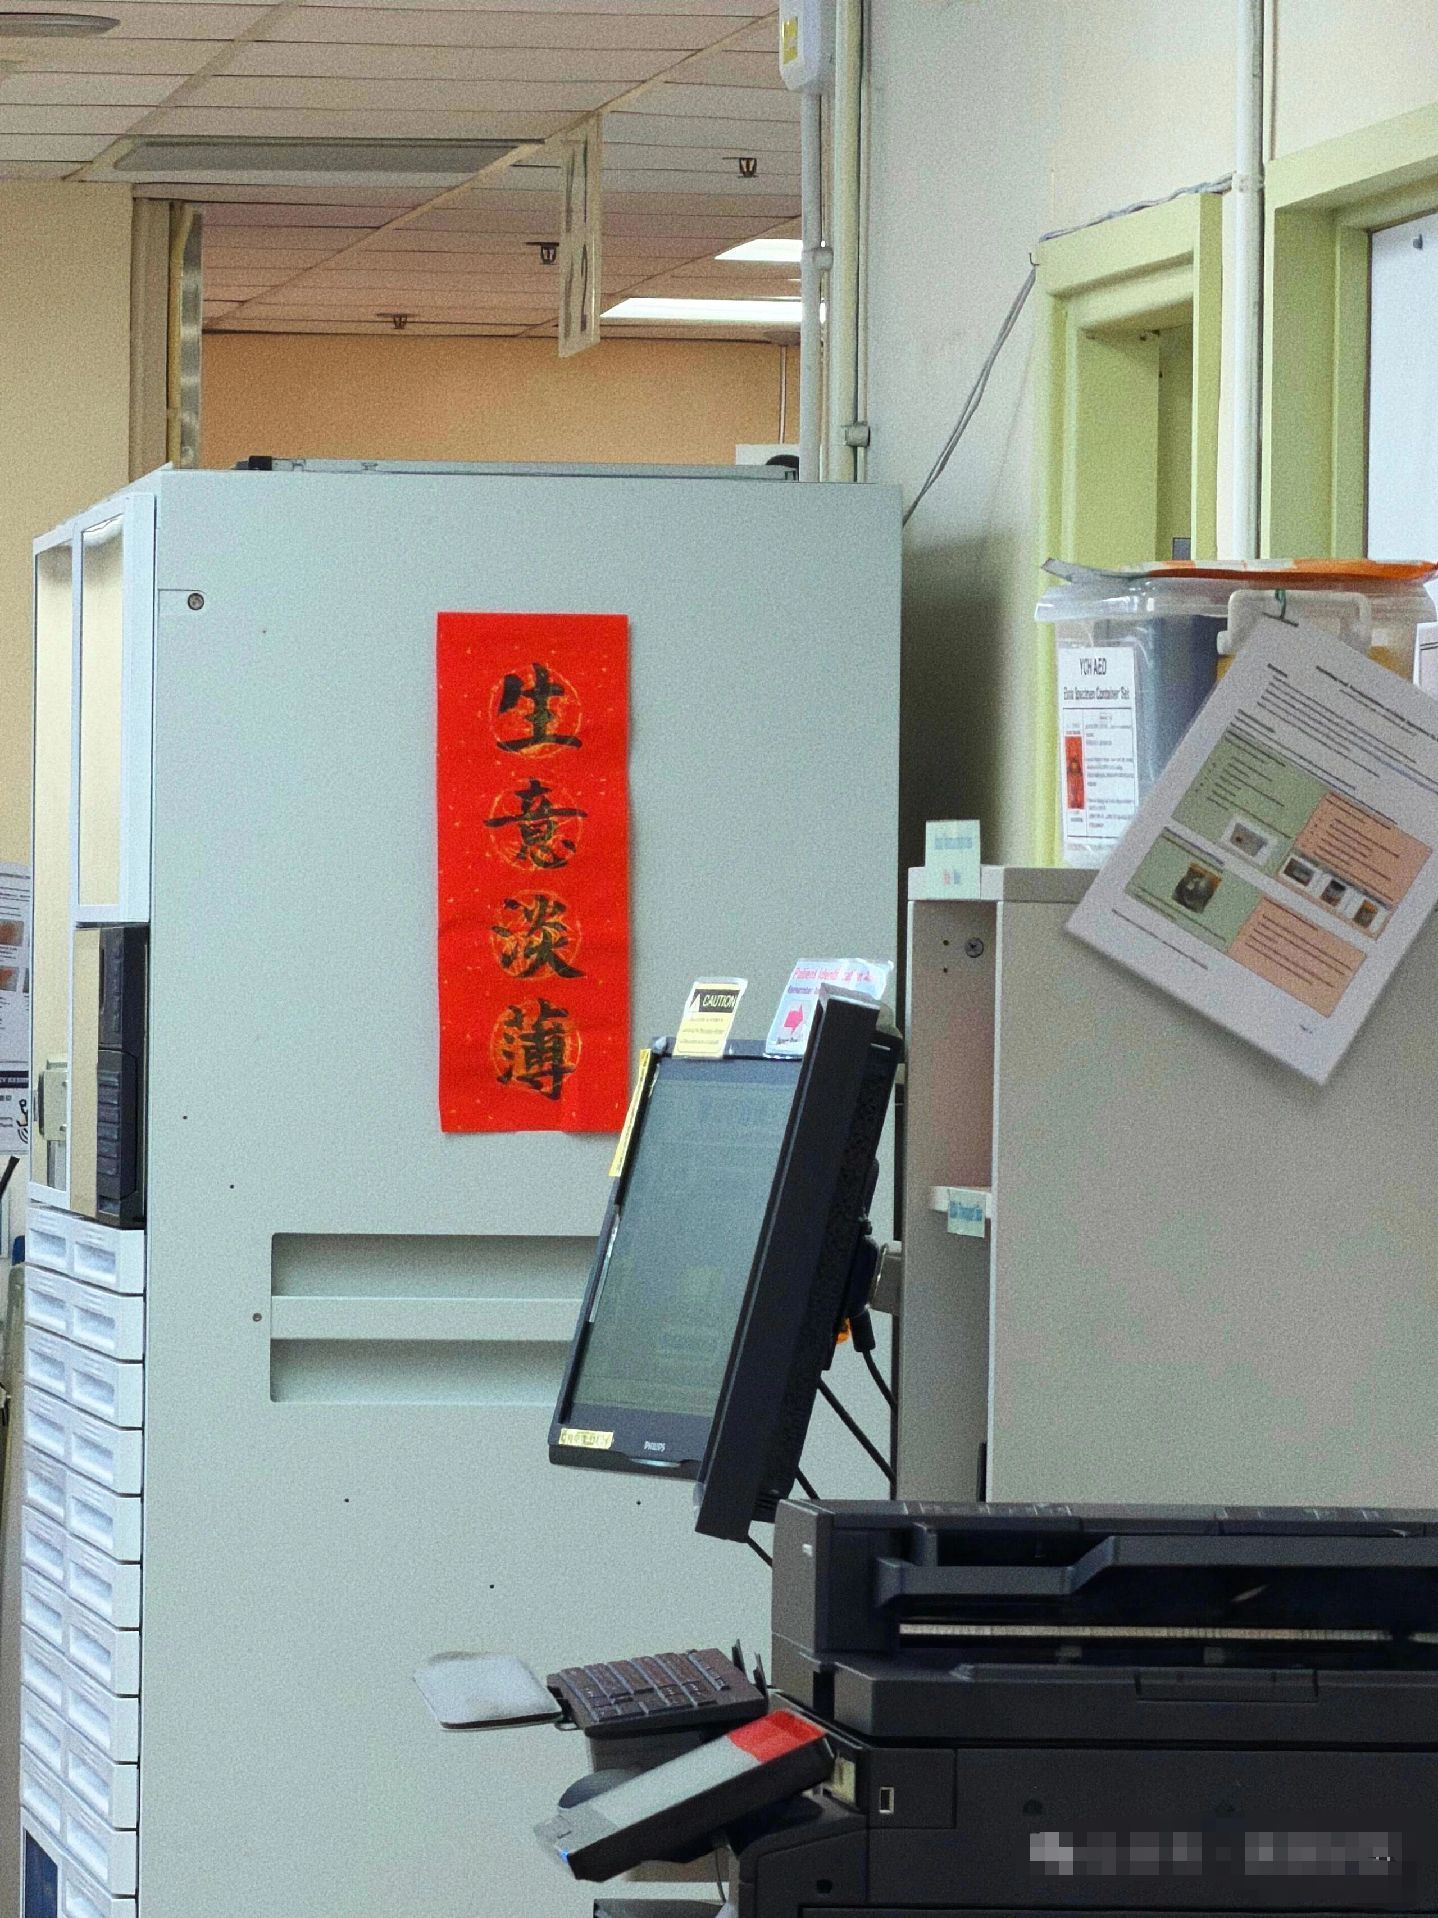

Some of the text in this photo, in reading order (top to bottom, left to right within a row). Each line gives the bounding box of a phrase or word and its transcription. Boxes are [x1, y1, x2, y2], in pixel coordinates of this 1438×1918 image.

[482, 662, 588, 1101] 生意淡薄
[702, 994, 737, 1009] CAUTION
[643, 1440, 666, 1452] PHILIPS
